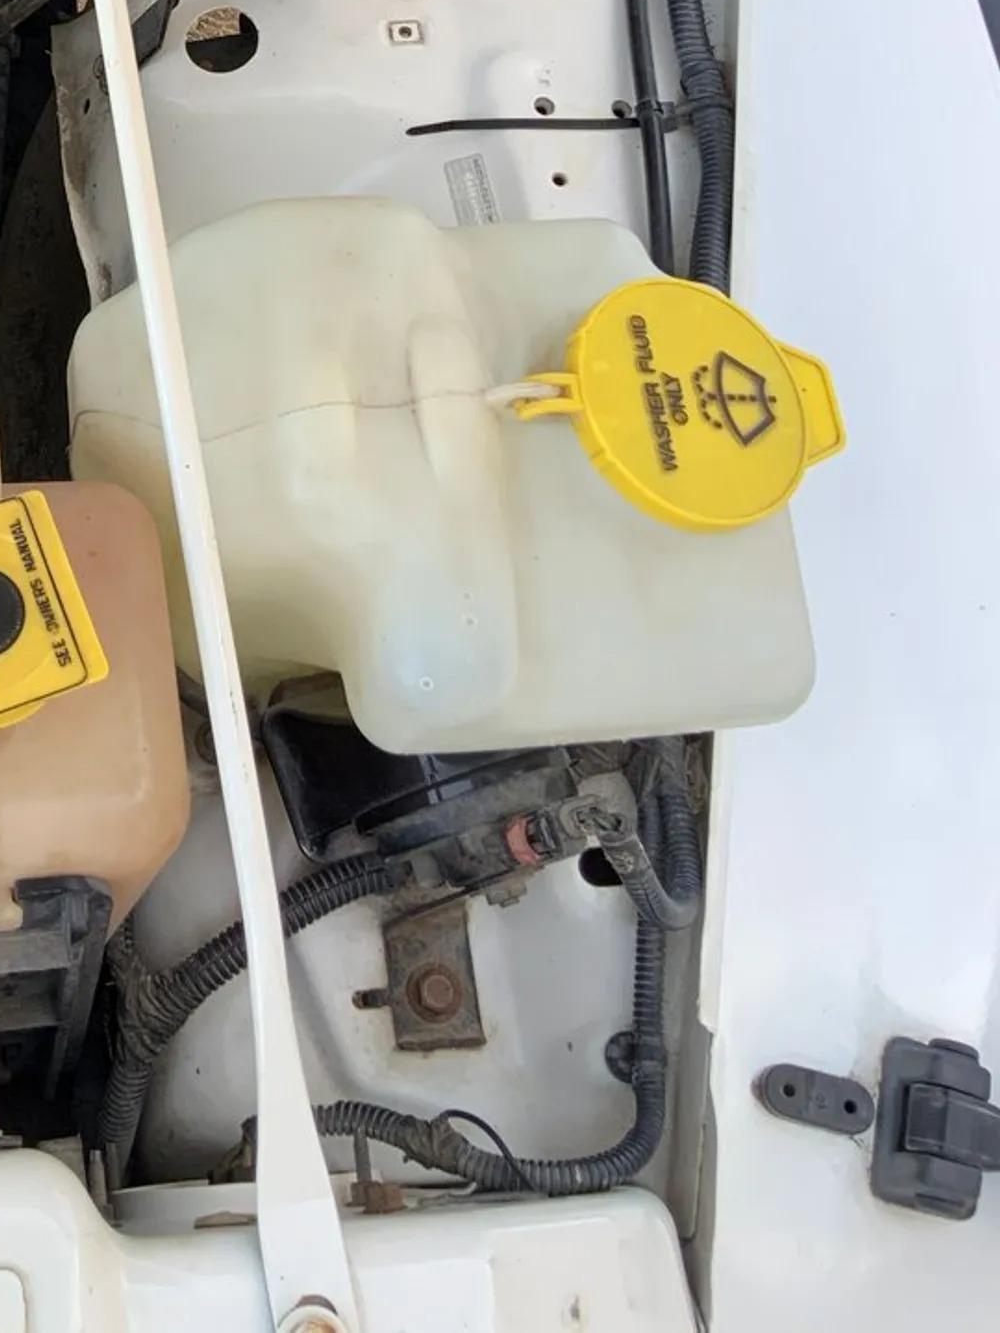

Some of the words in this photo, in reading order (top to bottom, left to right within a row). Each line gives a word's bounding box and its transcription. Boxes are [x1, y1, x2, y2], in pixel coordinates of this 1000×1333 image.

[629, 315, 656, 374] FLUID
[643, 382, 678, 472] WASHER
[660, 372, 689, 426] ONLY
[8, 518, 37, 573] MANUAL
[29, 577, 60, 635] OWNERS
[51, 638, 72, 668] SEE
